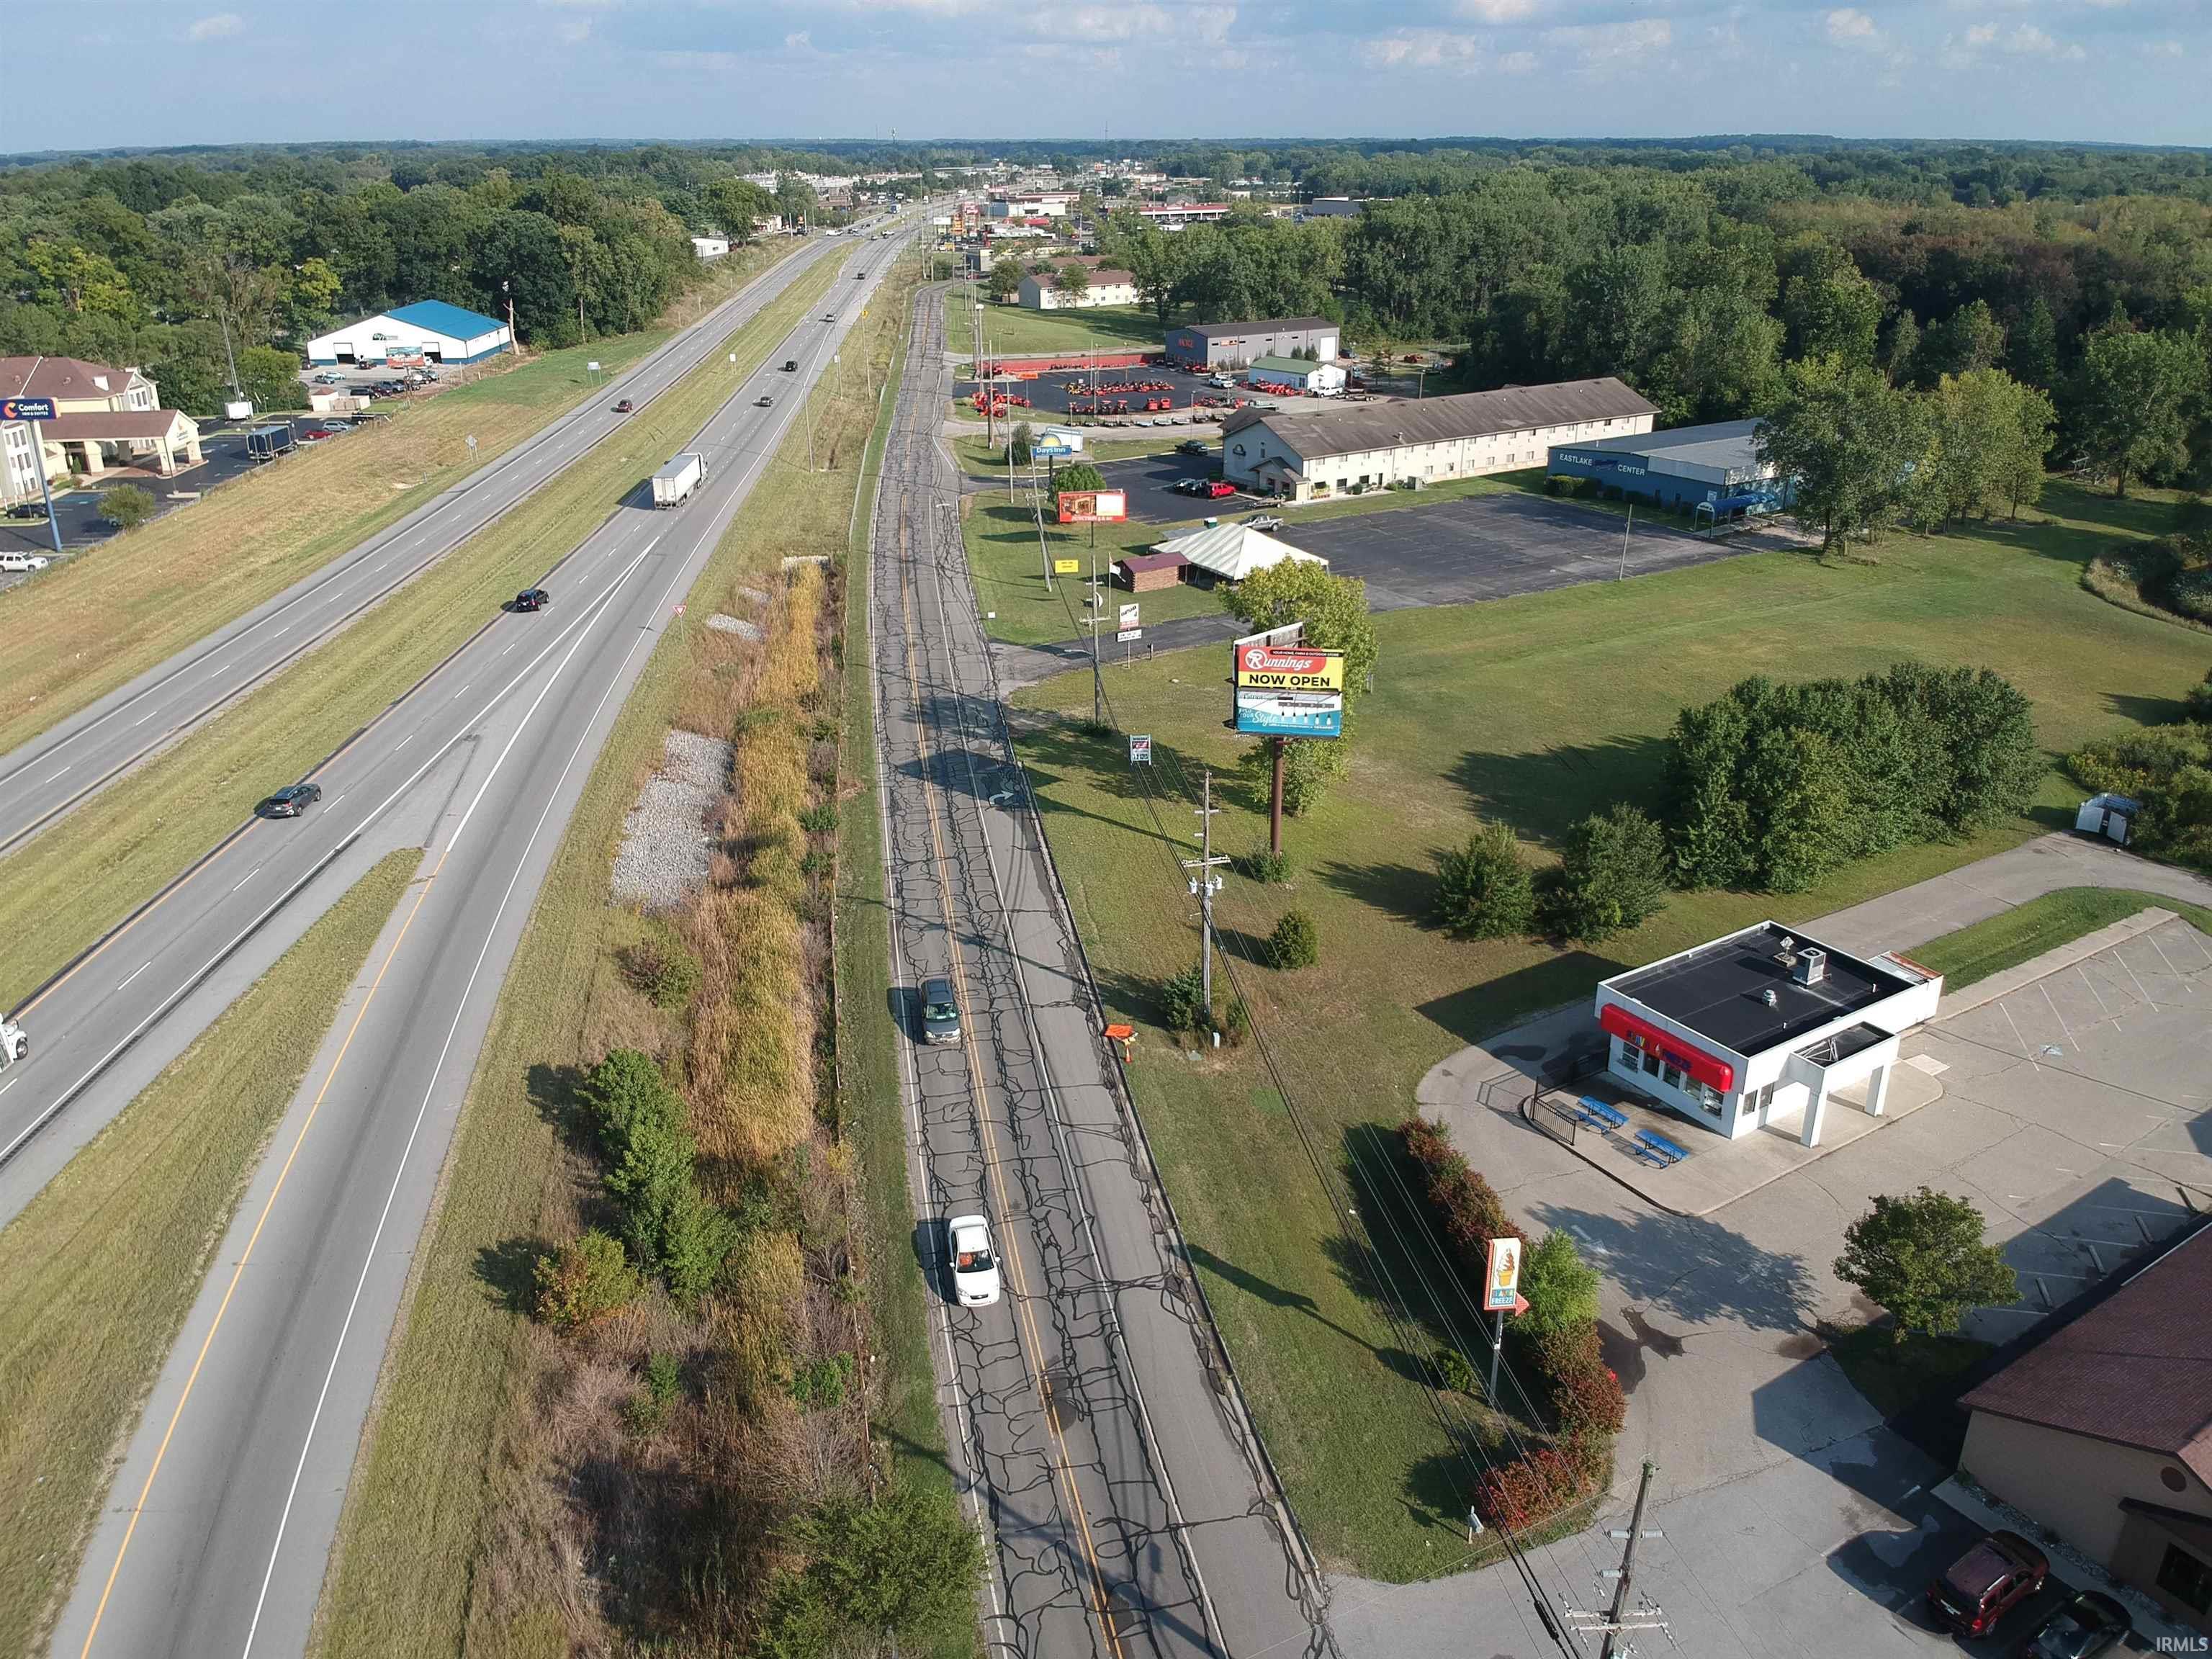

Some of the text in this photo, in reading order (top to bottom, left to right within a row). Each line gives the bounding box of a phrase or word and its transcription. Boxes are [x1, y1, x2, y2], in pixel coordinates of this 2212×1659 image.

[18, 403, 49, 411] Comfort
[1559, 453, 1645, 476] EASTLAKE CENTER
[1245, 649, 1313, 670] Runnings
[1249, 674, 1330, 686] NOW OPEN
